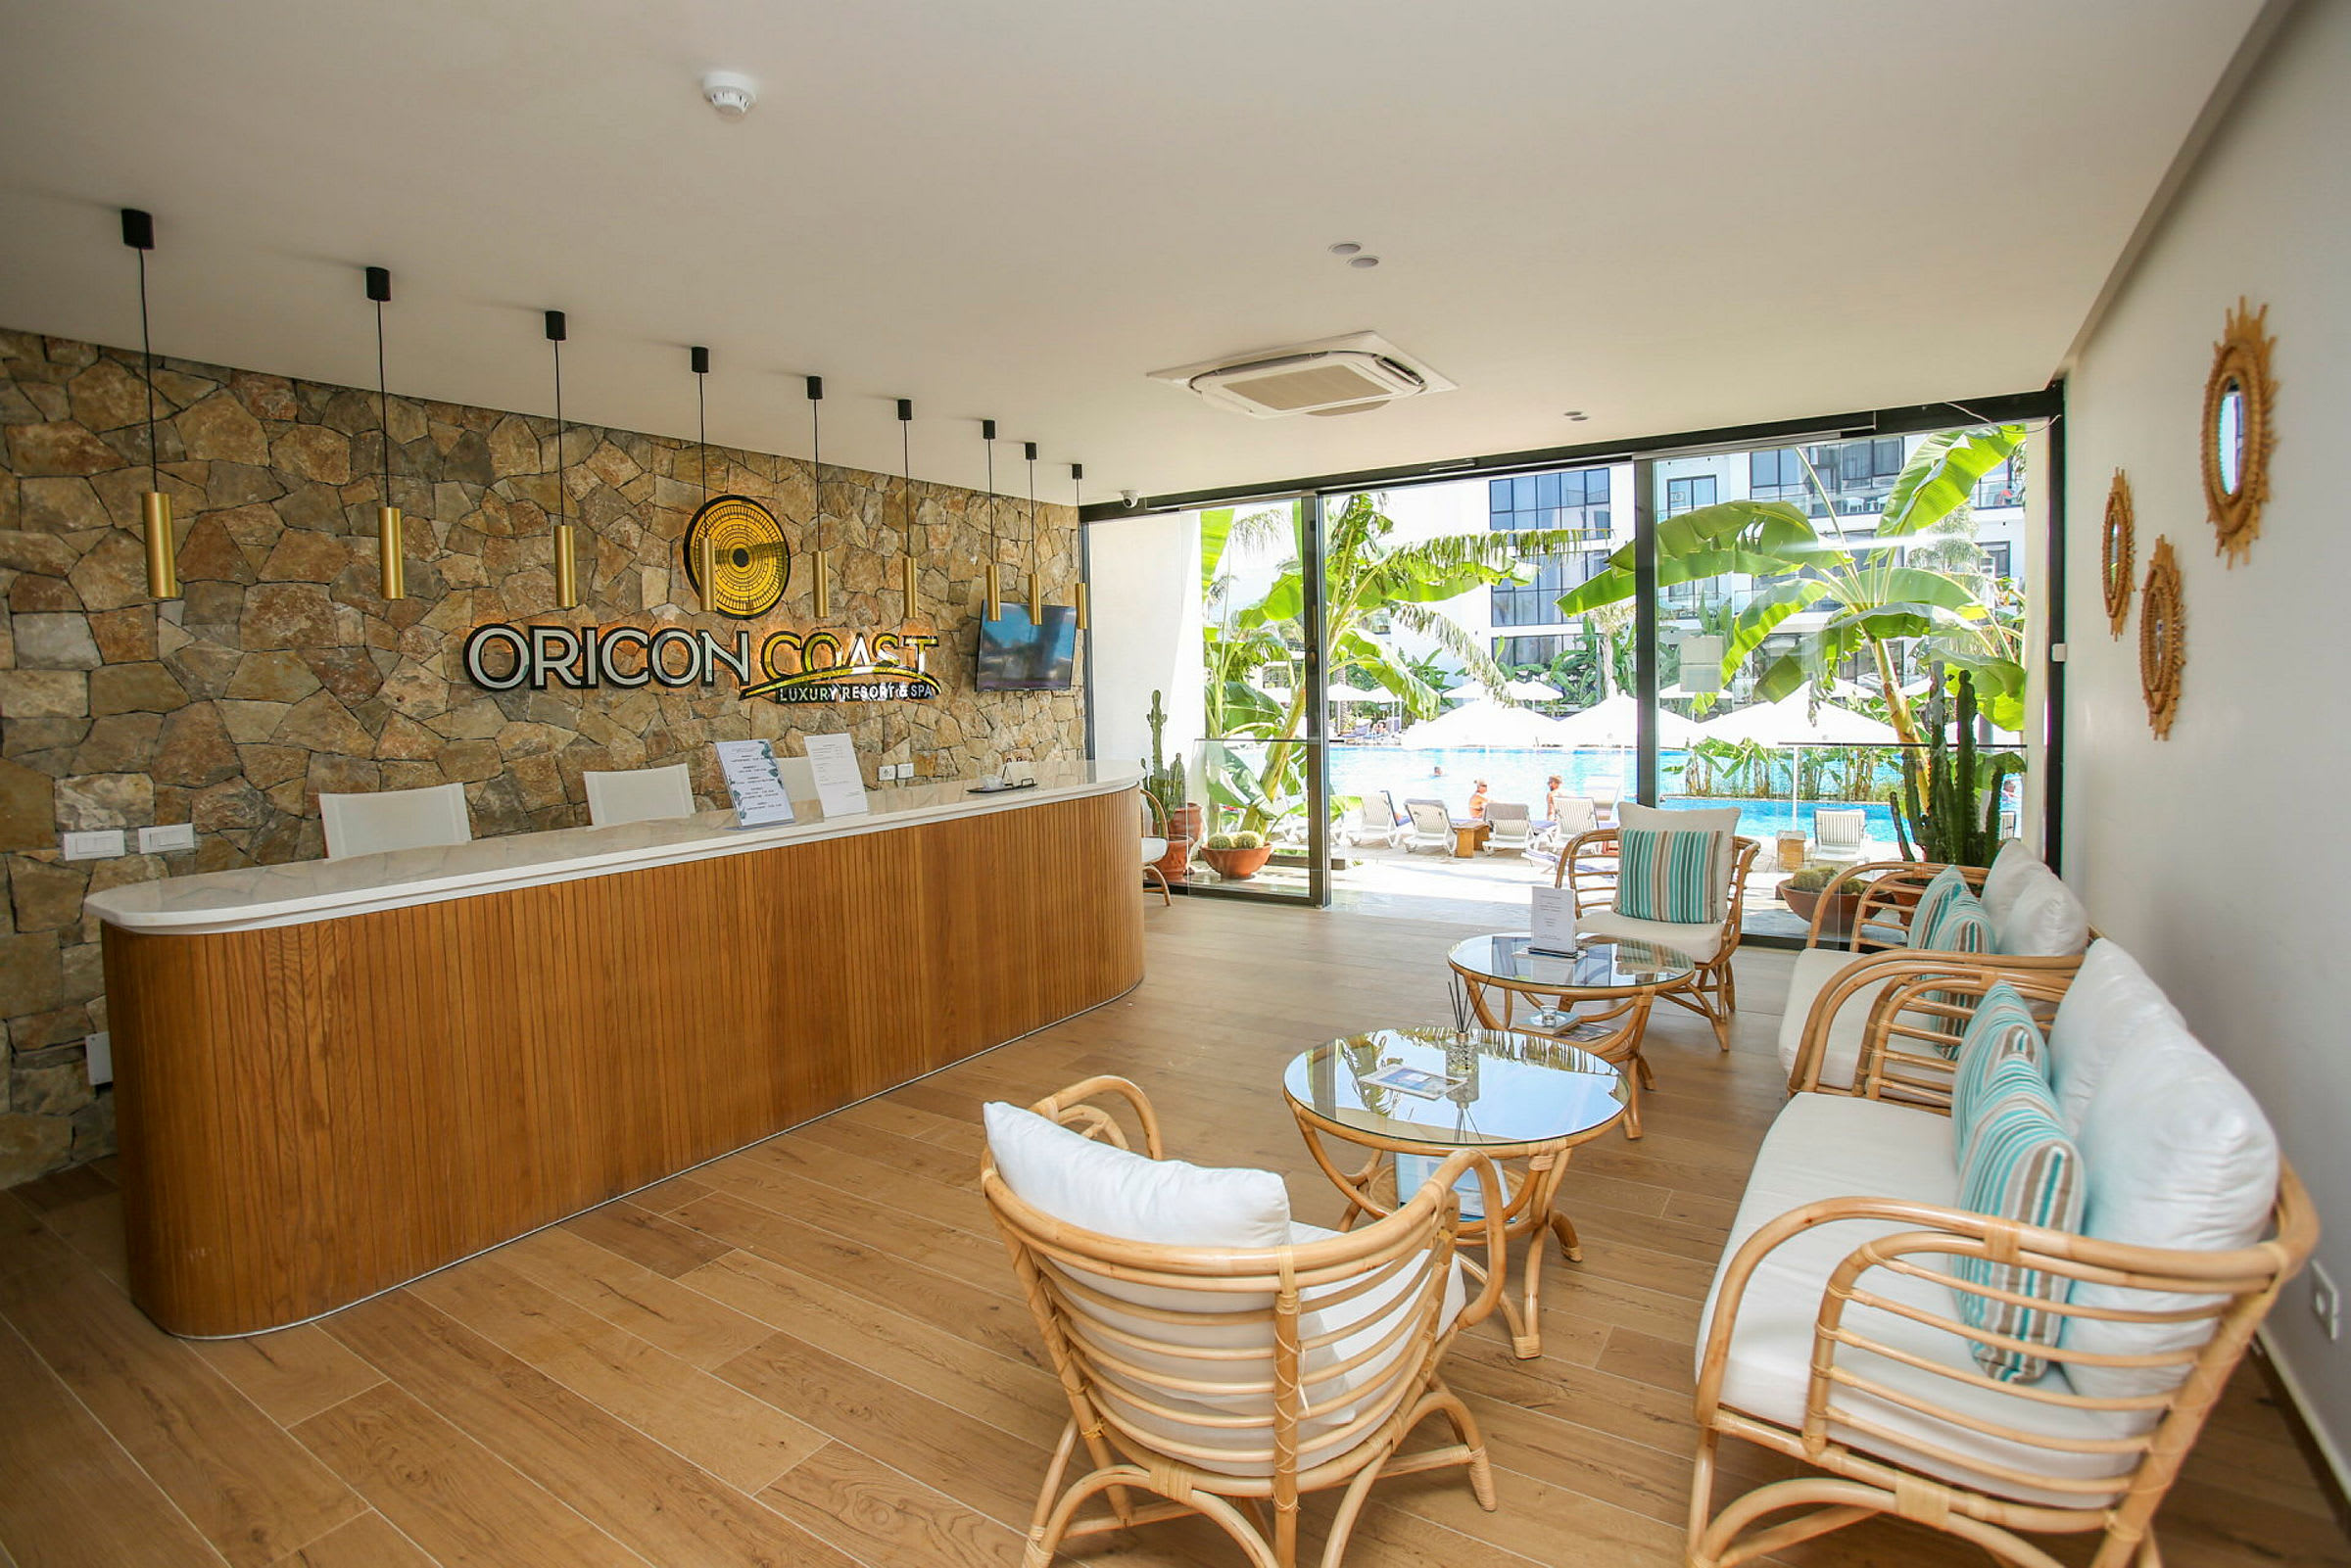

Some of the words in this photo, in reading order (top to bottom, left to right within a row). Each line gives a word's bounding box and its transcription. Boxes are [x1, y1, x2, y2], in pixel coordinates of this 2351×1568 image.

[463, 623, 750, 691] ORICON
[761, 631, 938, 683] COAST
[780, 688, 838, 702] LUXURY
[842, 685, 894, 700] RESORT
[911, 685, 933, 697] SPA
